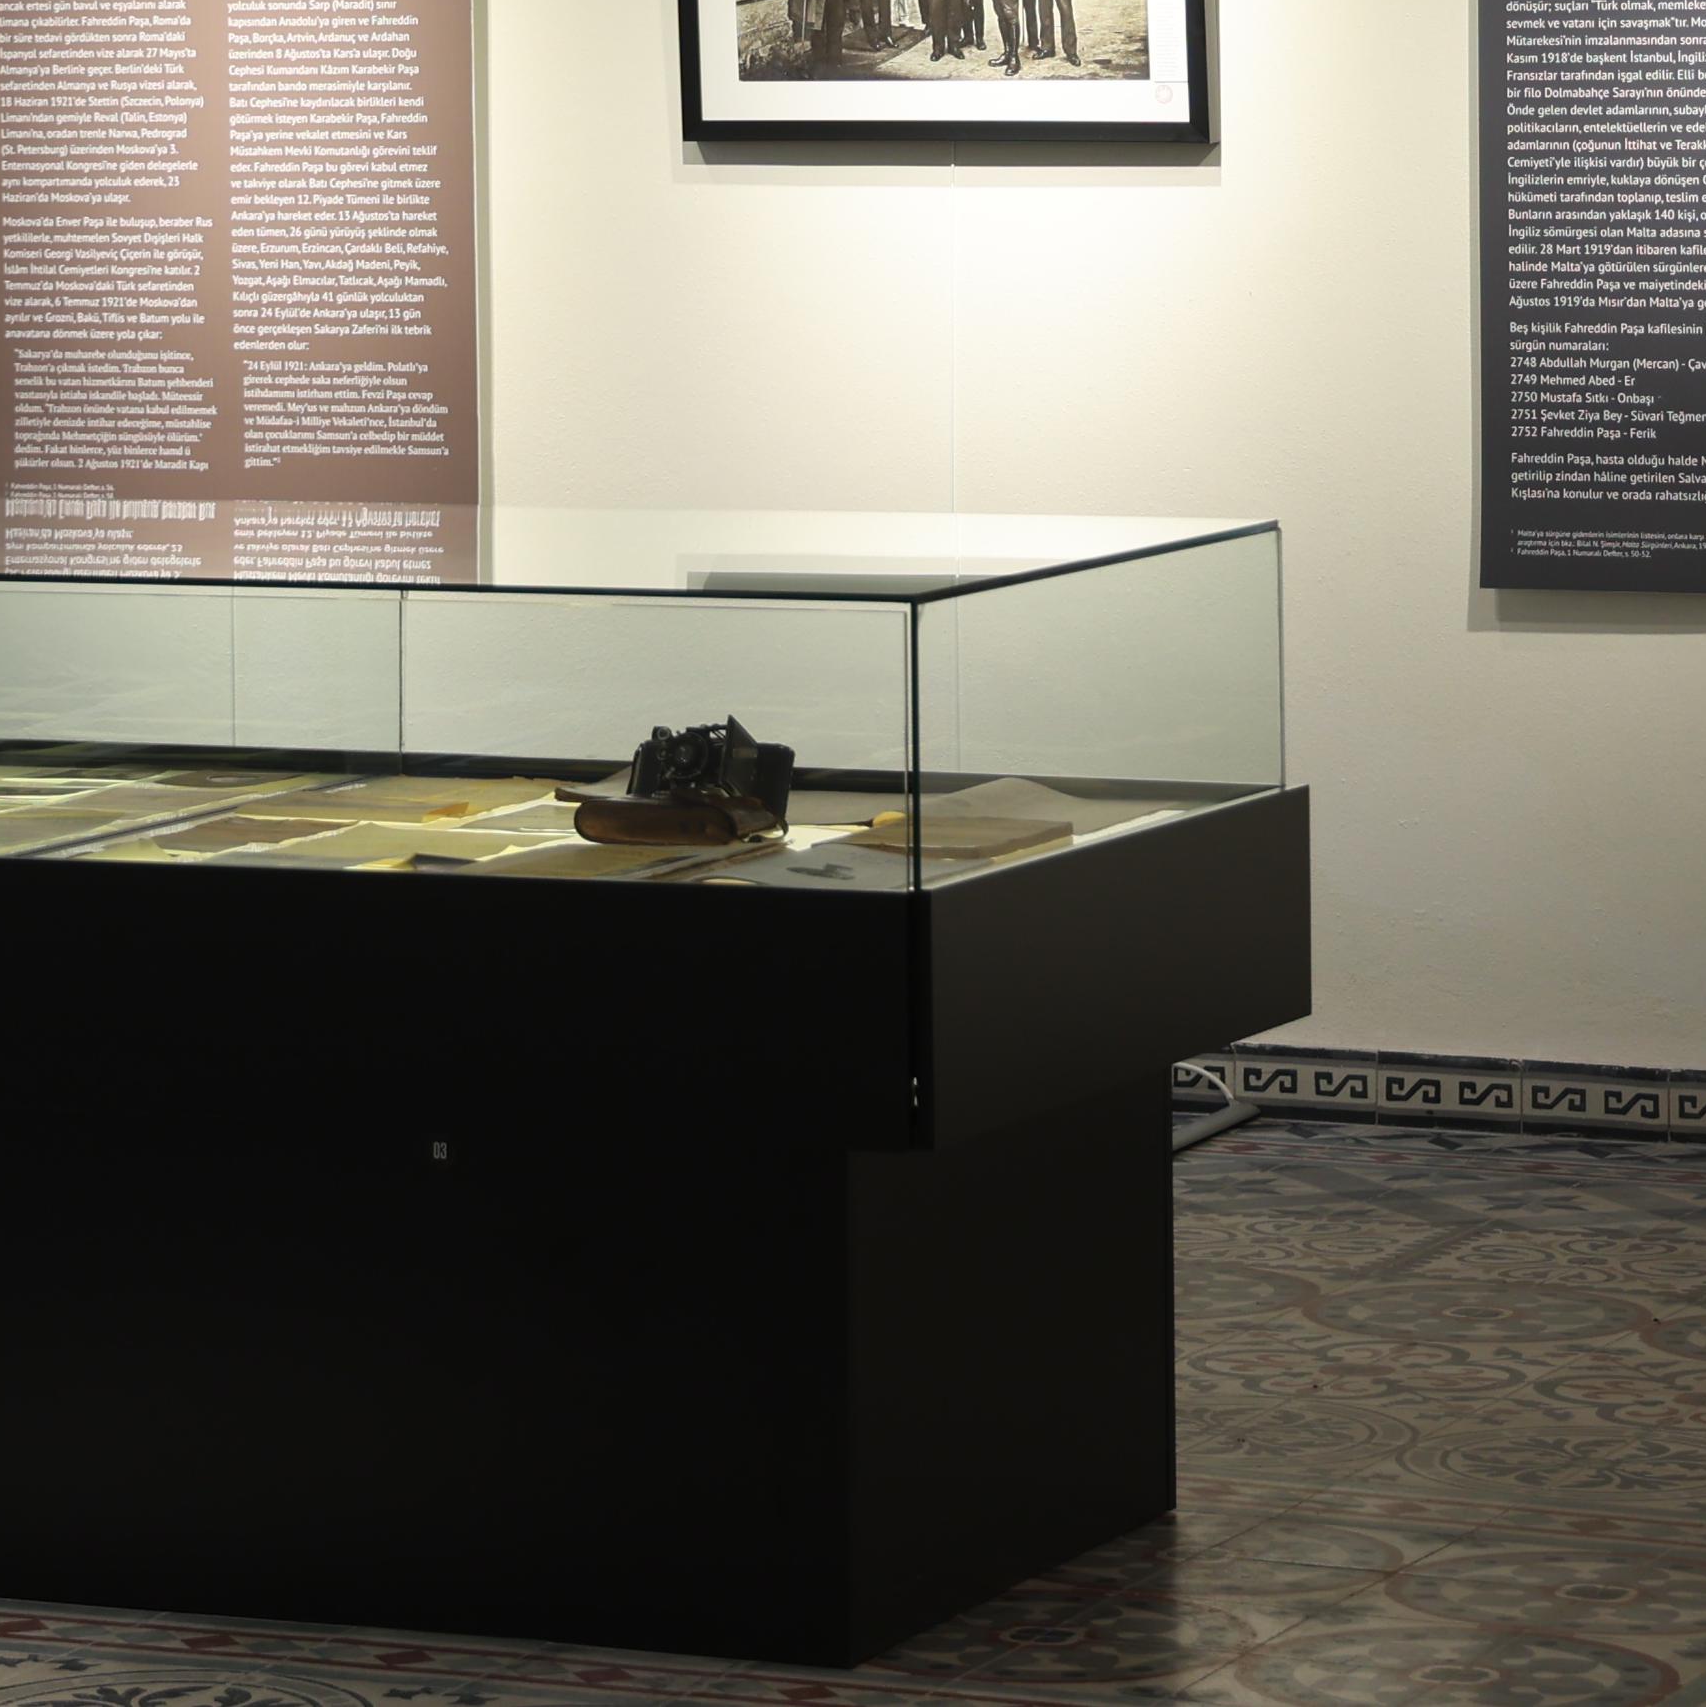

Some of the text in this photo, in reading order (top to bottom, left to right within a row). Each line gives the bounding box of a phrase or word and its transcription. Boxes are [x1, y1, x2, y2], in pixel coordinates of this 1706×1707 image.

[228, 65, 266, 77] Cephesi
[265, 64, 319, 75] Kumandanı
[350, 64, 396, 74] Karabekir
[396, 63, 419, 76] Paşa
[229, 161, 428, 174] eder. Fahreddin Paşa bu görevi kabul etmez
[230, 194, 430, 207] emir bekleyen 12. Piyade Tümeni ile birlikte
[1507, 191, 1558, 202] hükümeti
[1559, 192, 1615, 202] tarafından
[1616, 192, 1665, 205] toplanıp,
[1665, 192, 1700, 202] teslim
[1508, 224, 1542, 239] İngiliz
[1543, 226, 1598, 240] sömürgesi
[1599, 227, 1625, 237] olan
[1626, 226, 1657, 237] Malta
[1659, 227, 1702, 238] adasına
[1508, 243, 1538, 254] edilir.
[1539, 243, 1554, 254] 28
[1555, 244, 1582, 254] Mart
[1635, 244, 1678, 255] itibaren
[233, 323, 256, 334] önce
[256, 323, 313, 337] gerçekleşen
[313, 323, 351, 337] Sakarya
[390, 324, 403, 335] ilk
[403, 324, 432, 335] tebrik
[1509, 322, 1529, 335] Beş
[1530, 322, 1563, 335] kişilik
[1564, 322, 1618, 334] Fahreddin
[1620, 323, 1645, 336] Paşa
[1647, 323, 1704, 334] kafilesinin
[1509, 339, 1609, 352] sürgün numaraları:
[1510, 356, 1537, 368] 2748
[1539, 357, 1587, 368] Abdullah
[1589, 357, 1631, 371] Murgan
[1632, 358, 1680, 372] (Mercan)
[1511, 373, 1538, 385] 2749
[1539, 374, 1587, 386] Mehmed
[1587, 375, 1617, 386] Abed
[1623, 375, 1635, 386] Er
[1511, 391, 1539, 402] 2750
[1539, 391, 1583, 403] Mustafa
[1584, 392, 1610, 403] Sıtkı
[1617, 392, 1655, 406] Onbaşı
[1511, 408, 1539, 420] 2751
[1540, 409, 1576, 423] Şevket
[1577, 409, 1601, 423] Ziya
[1602, 409, 1623, 423] Bey
[1630, 410, 1665, 421] Süvari
[1511, 426, 1538, 437] 2752
[1540, 426, 1595, 438] Fahreddin
[1596, 427, 1622, 440] Paşa
[1629, 427, 1657, 439] Ferik
[432, 1141, 447, 1159] 03
